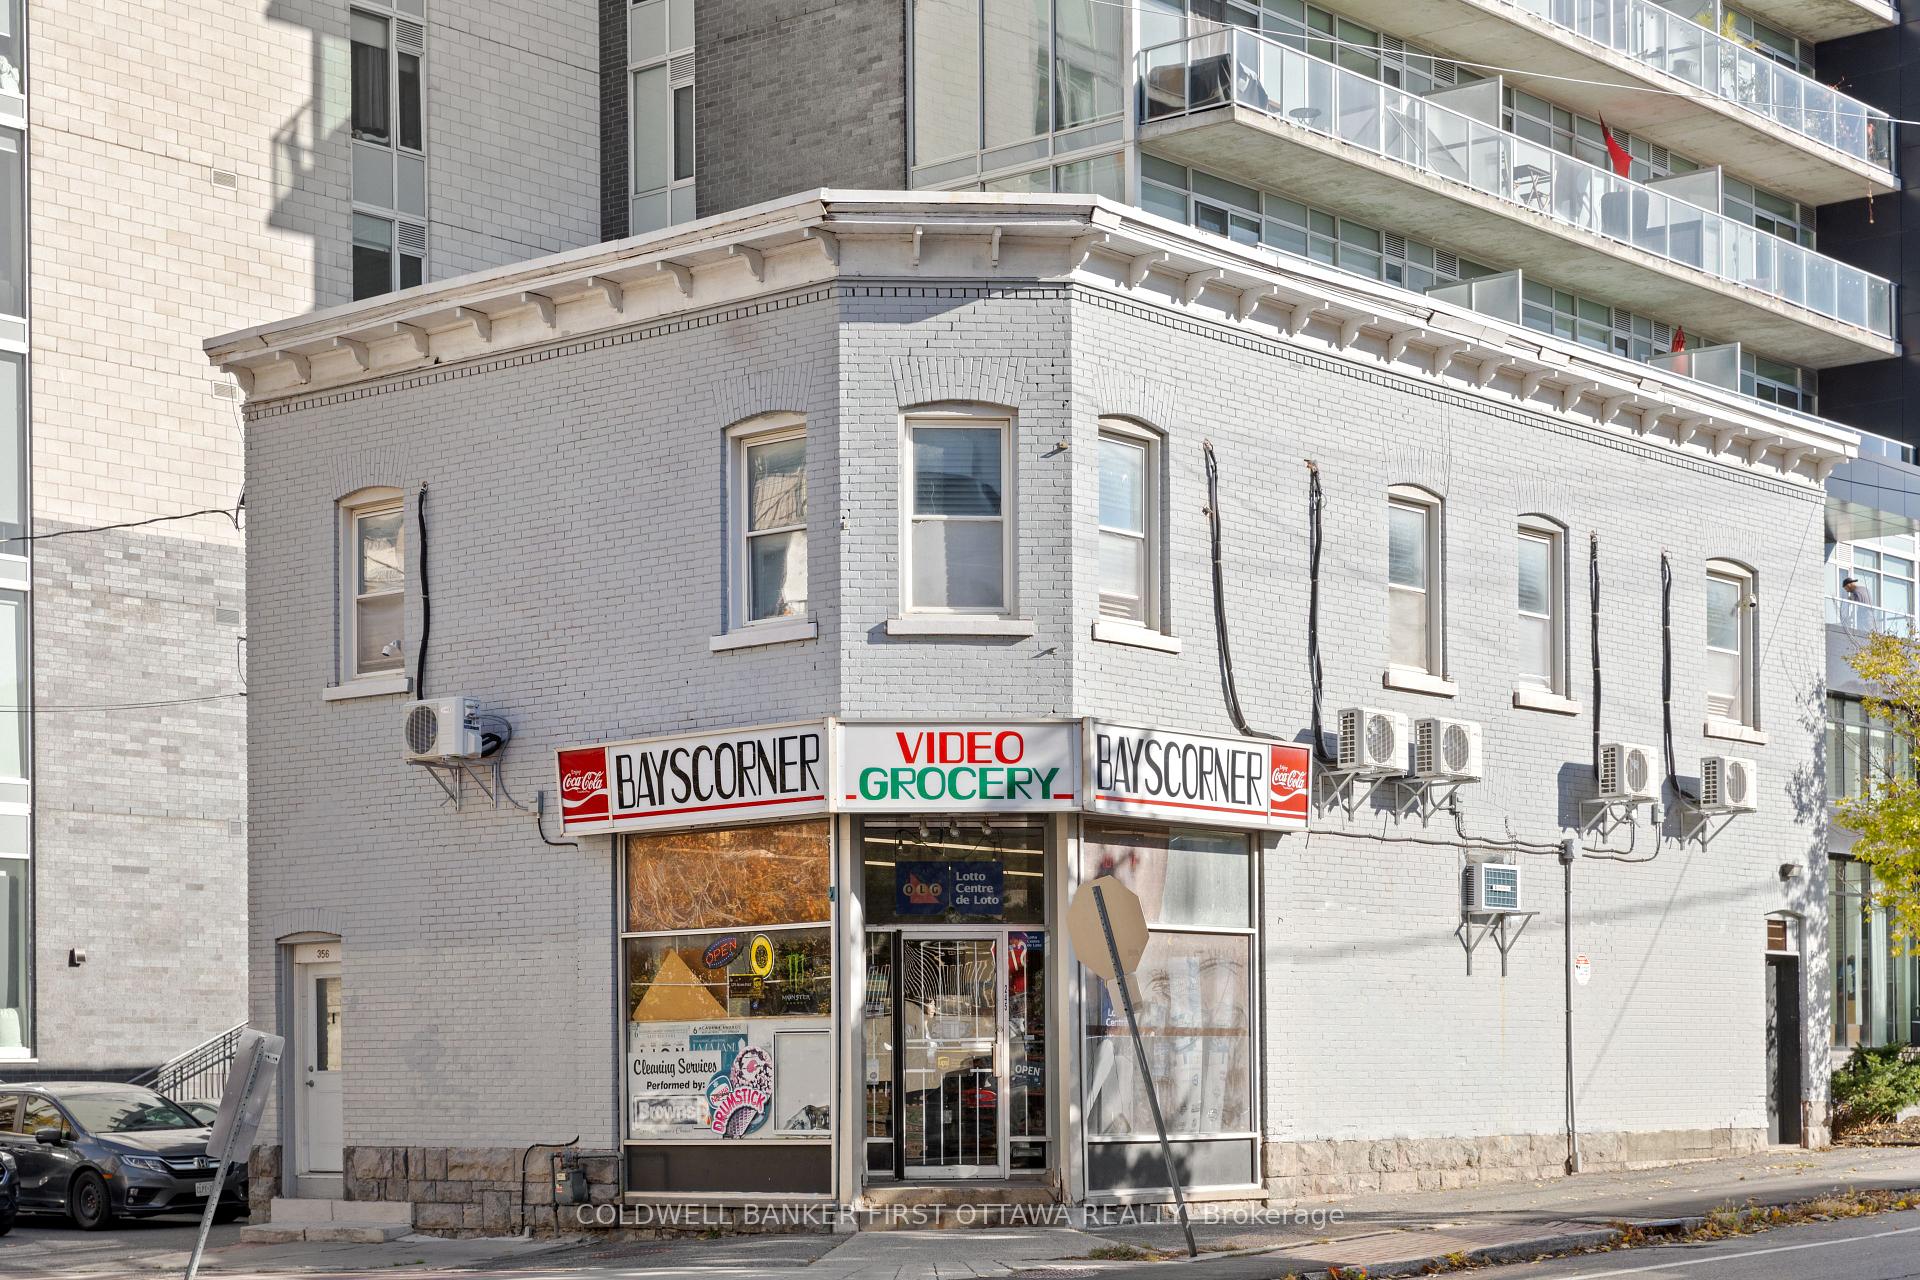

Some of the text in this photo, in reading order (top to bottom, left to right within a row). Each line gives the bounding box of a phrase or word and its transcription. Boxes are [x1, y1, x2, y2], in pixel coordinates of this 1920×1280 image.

[895, 731, 1025, 764] VIDEO
[616, 733, 820, 810] BAYSCORNER
[1096, 734, 1263, 807] BAYSCORNER
[859, 766, 1060, 801] GROCERY
[955, 871, 986, 881] Lotto
[904, 885, 941, 895] OLG
[955, 883, 994, 893] Centre
[955, 895, 1000, 905] de Loto
[316, 949, 330, 959] 356
[705, 938, 738, 964] OPEN
[633, 1057, 717, 1078] Cleaning Services
[1015, 1064, 1041, 1077] OPEN
[646, 1080, 706, 1091] Performed by:
[712, 1087, 766, 1133] DRUMSTICK
